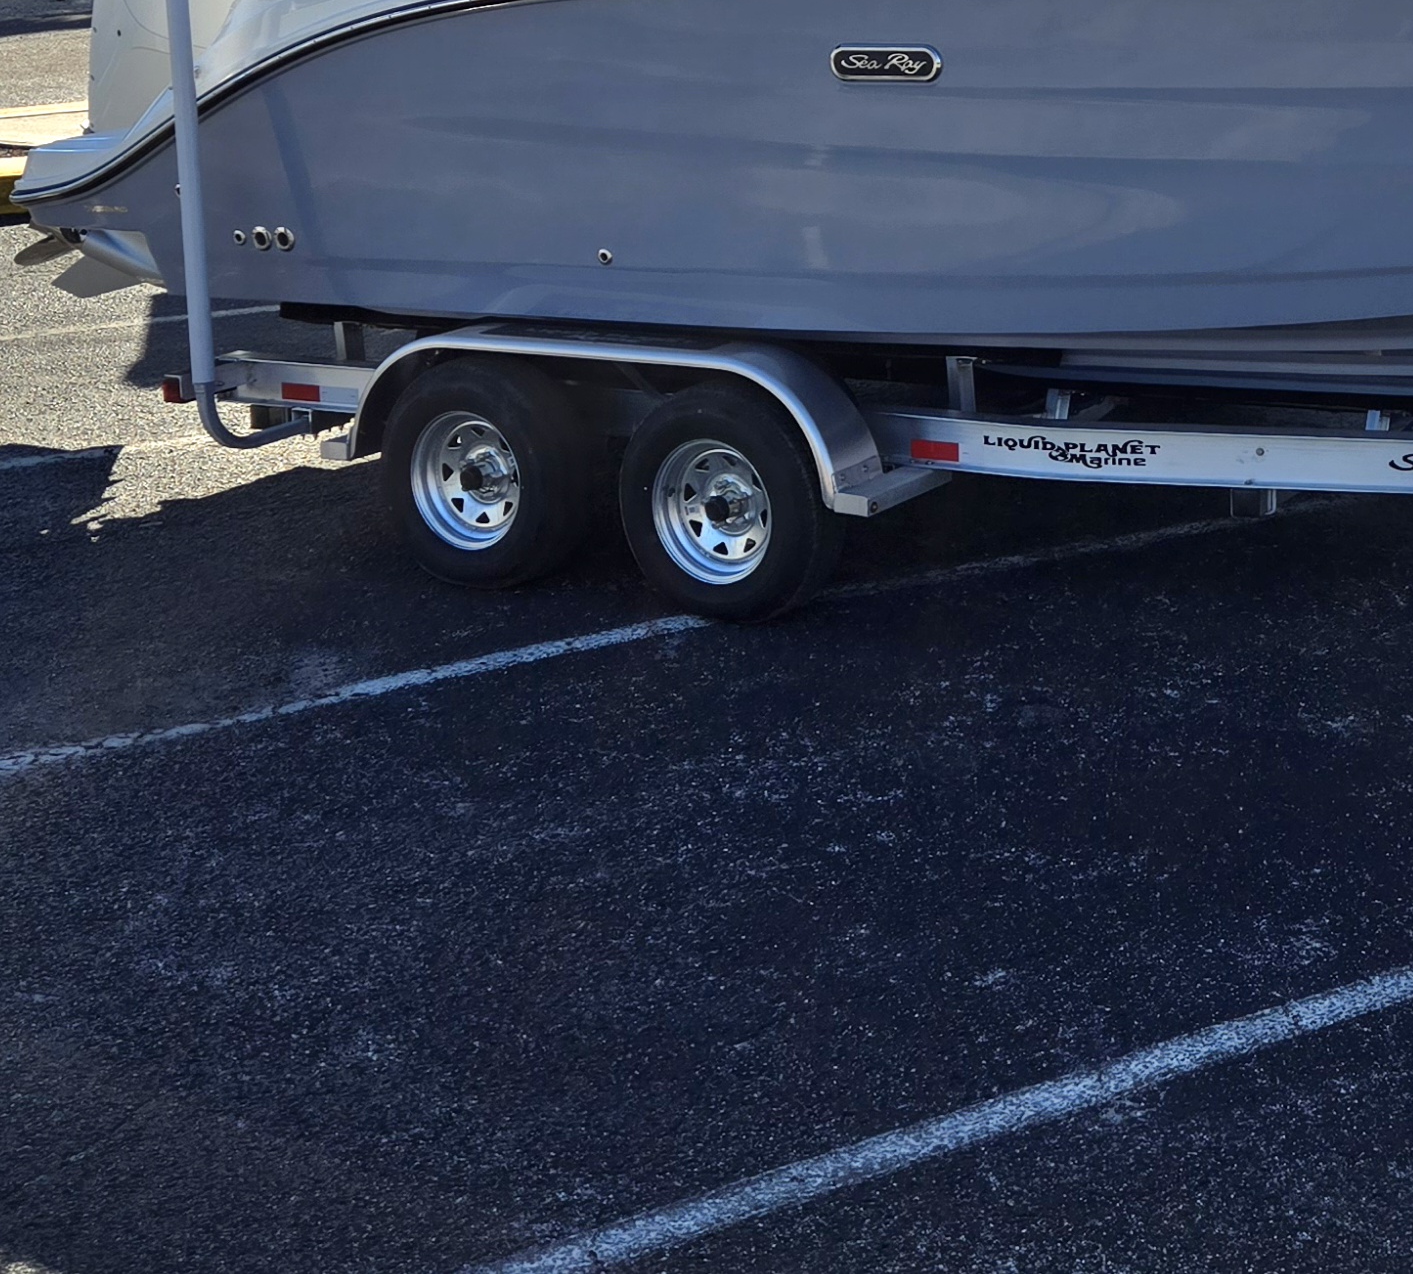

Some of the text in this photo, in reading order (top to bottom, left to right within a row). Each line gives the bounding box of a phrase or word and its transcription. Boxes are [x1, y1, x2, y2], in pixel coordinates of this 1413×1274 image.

[840, 53, 927, 75] Sea Ray
[983, 435, 1161, 457] LIQUID PLANET
[1069, 452, 1147, 469] Marine
